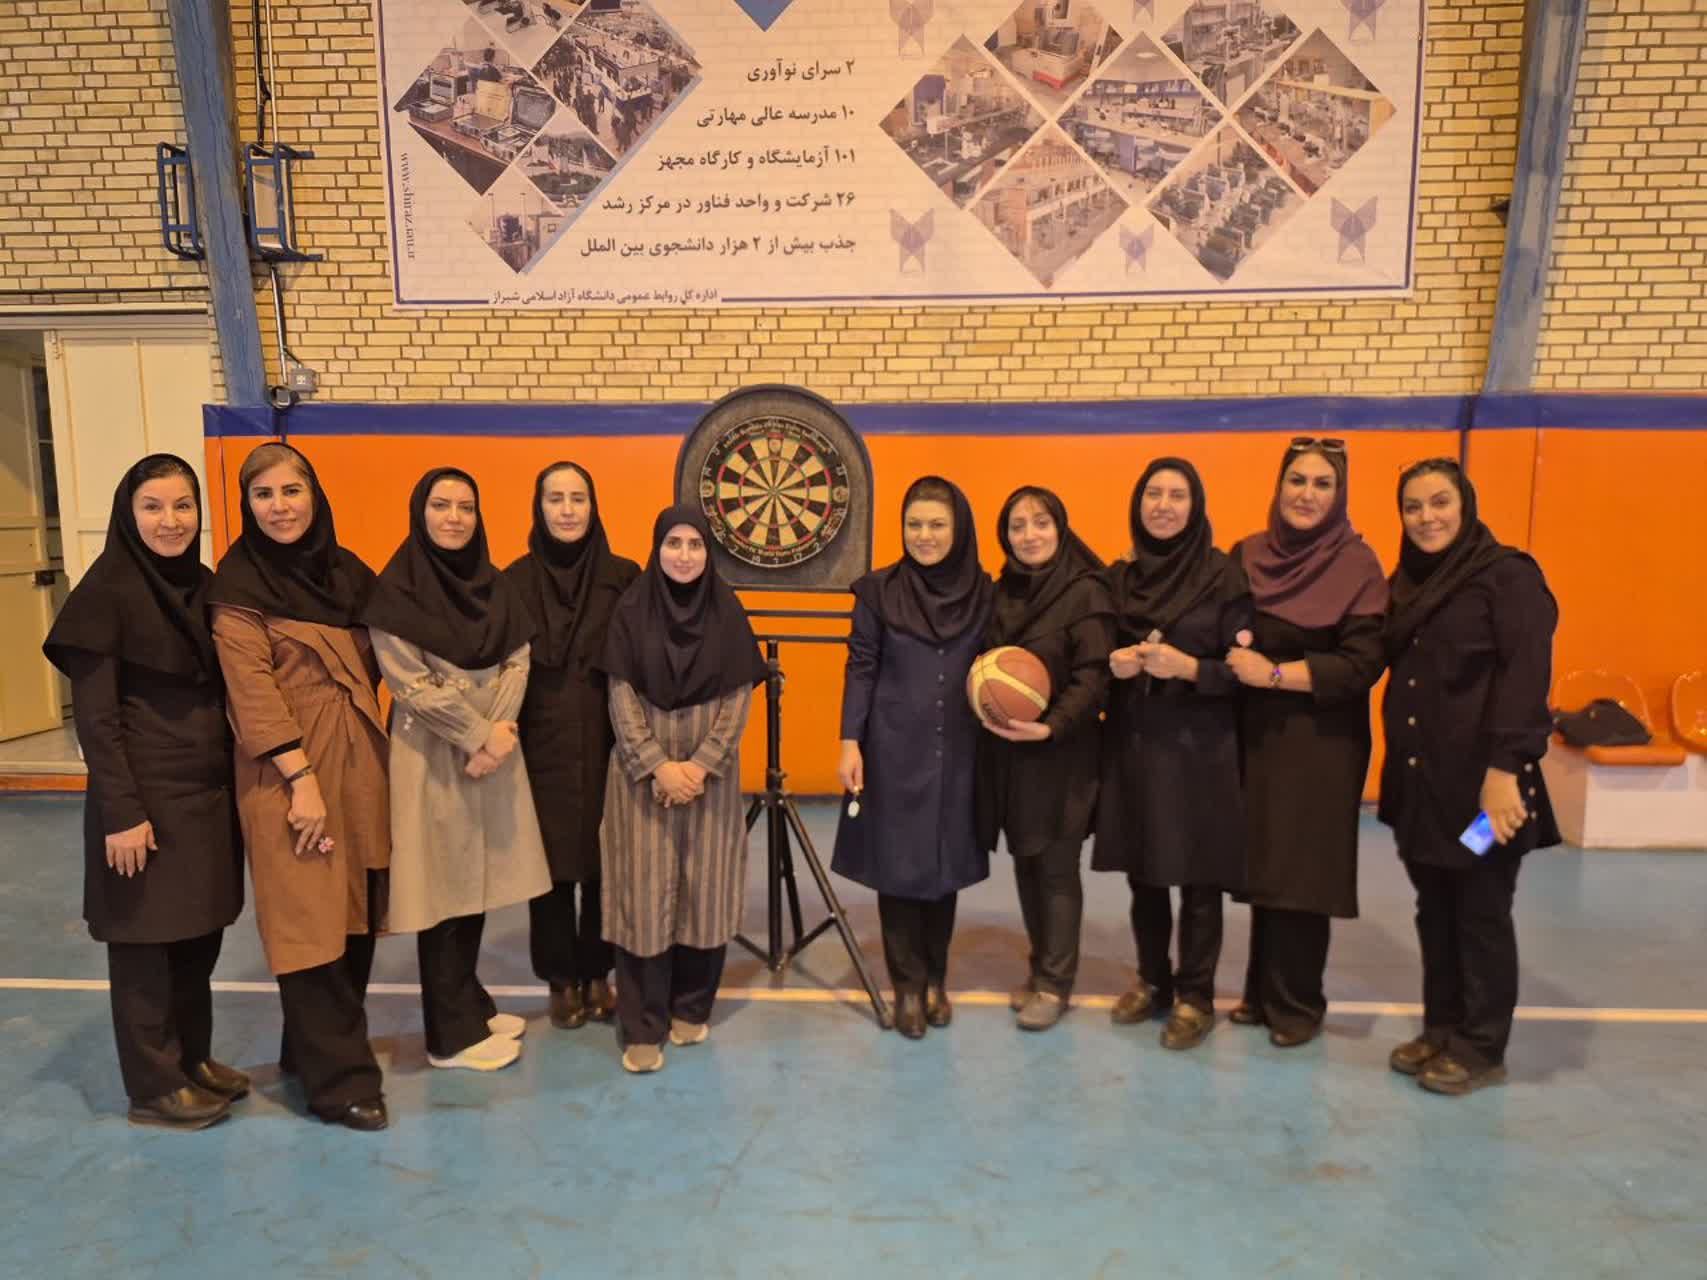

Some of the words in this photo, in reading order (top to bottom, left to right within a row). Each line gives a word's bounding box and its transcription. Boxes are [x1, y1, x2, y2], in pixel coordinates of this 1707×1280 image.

[747, 57, 798, 83] نوآوری
[801, 59, 842, 81] سرای
[697, 106, 747, 128] مهارتی
[751, 105, 785, 127] عالی
[788, 108, 838, 124] مدرسه
[841, 104, 855, 120] ۱۰
[657, 154, 695, 172] مجهز
[700, 150, 743, 170] کارگاه
[746, 156, 755, 170] و
[758, 145, 830, 169] آزمایشگاه
[834, 148, 856, 163] ۱۰۱
[602, 196, 633, 215] رشد
[638, 194, 671, 215] مرکز
[675, 197, 692, 215] در
[696, 193, 731, 214] فناور
[735, 193, 770, 213] واحد
[773, 199, 782, 213] و
[786, 191, 833, 212] شرکت
[581, 238, 616, 258] الملل
[620, 241, 645, 259] بین
[649, 237, 715, 257] دانشجوی
[720, 237, 749, 257] هزار
[768, 235, 779, 256] از
[784, 236, 815, 256] بیش
[818, 236, 857, 254] جذب
[493, 290, 520, 304] شیراز
[521, 290, 557, 304] اسلامی
[558, 288, 576, 304] آزاد
[578, 289, 616, 301] دانشگاه
[616, 292, 651, 304] عمومی
